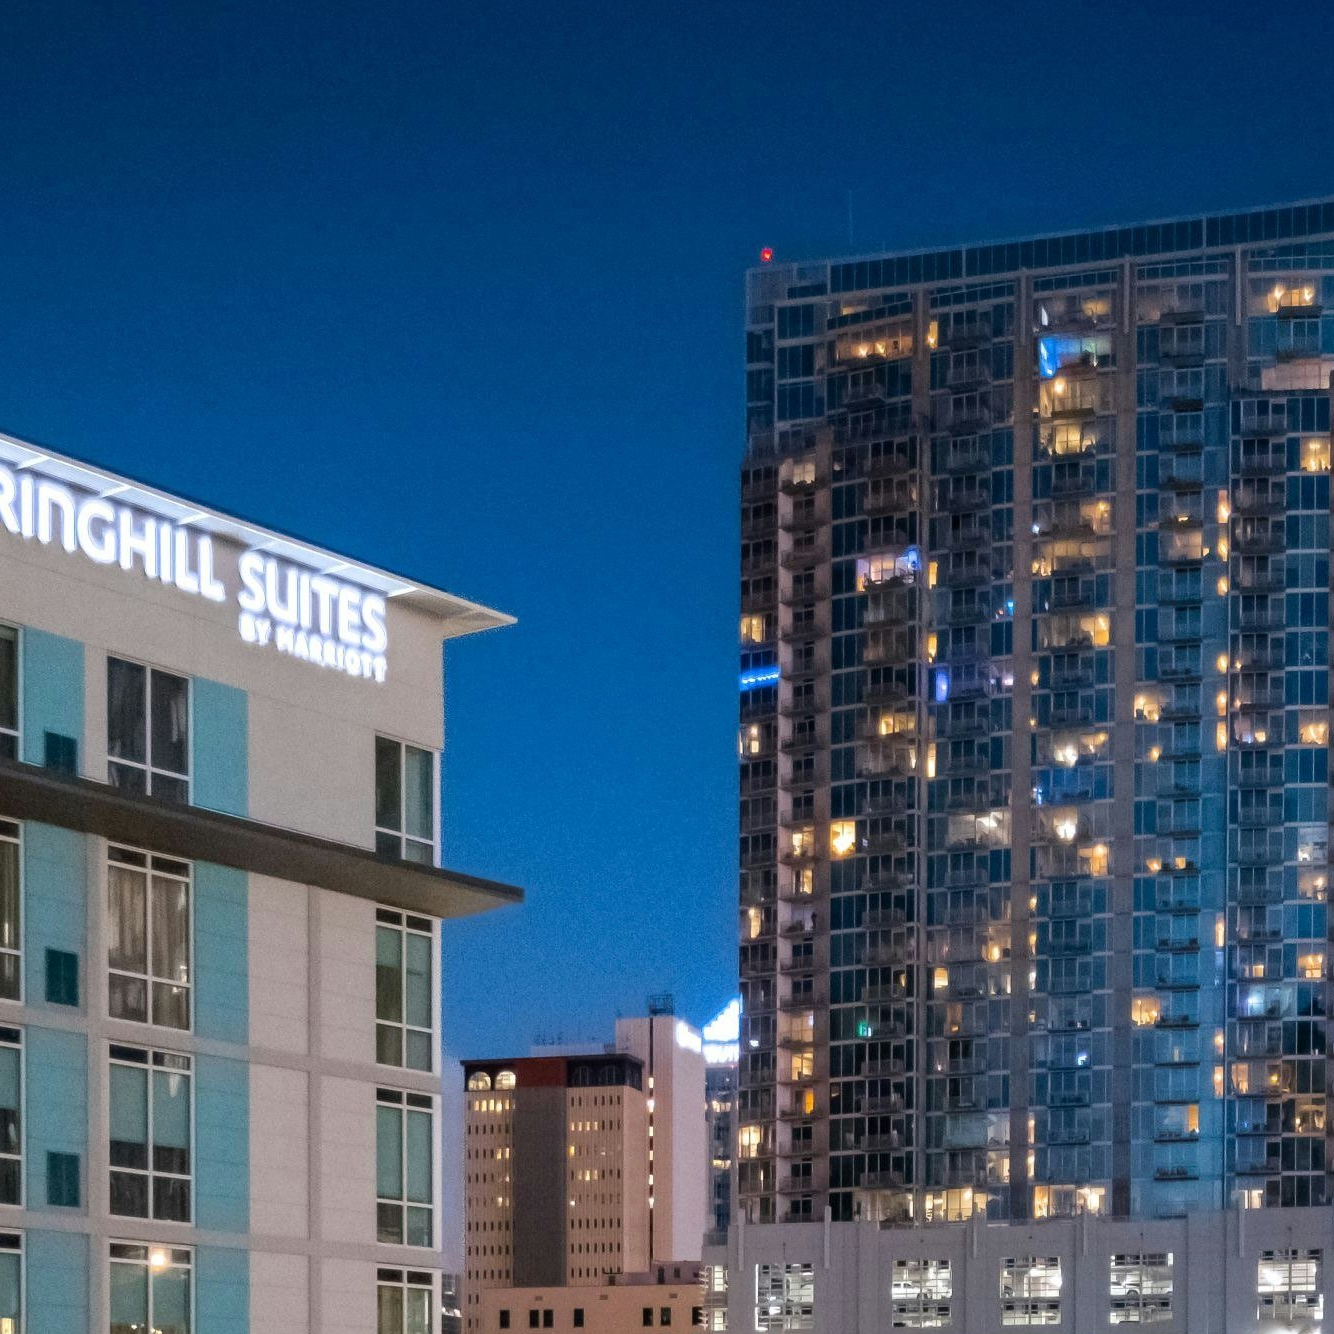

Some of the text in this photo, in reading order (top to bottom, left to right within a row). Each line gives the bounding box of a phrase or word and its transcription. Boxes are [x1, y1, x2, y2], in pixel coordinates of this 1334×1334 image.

[237, 549, 389, 653] SUITES
[239, 611, 388, 684] BY MARRIOTT
